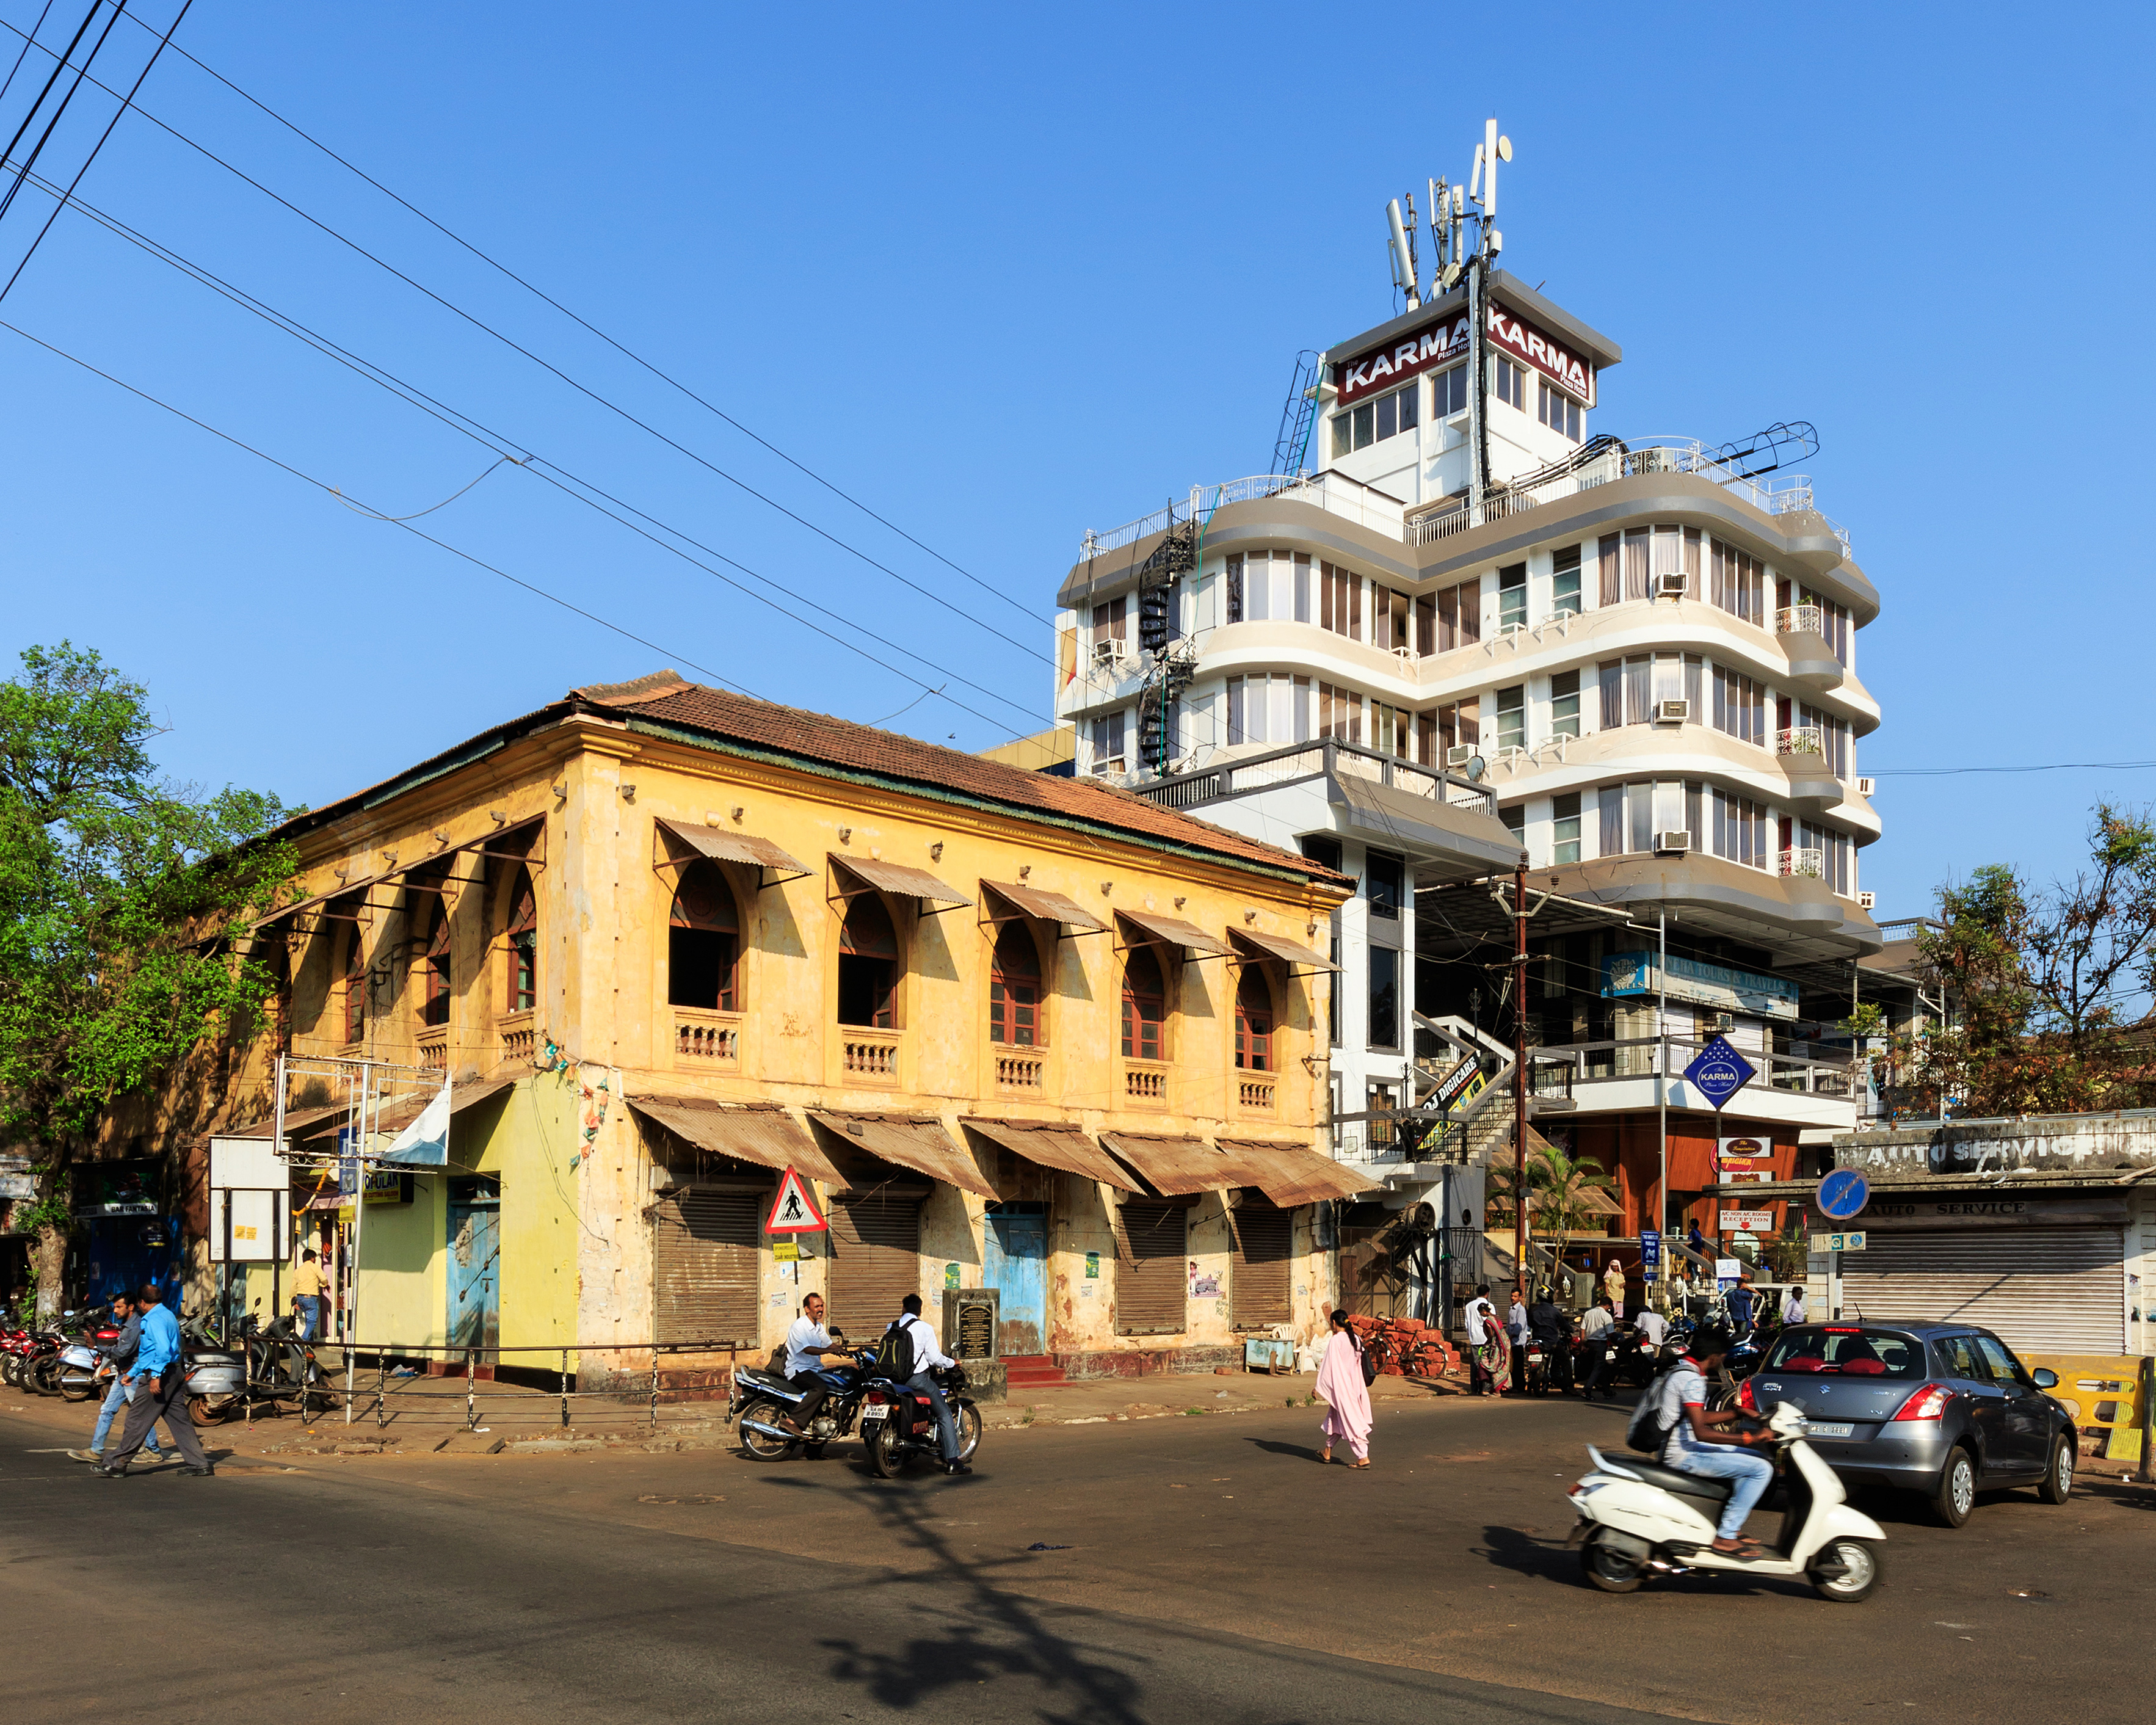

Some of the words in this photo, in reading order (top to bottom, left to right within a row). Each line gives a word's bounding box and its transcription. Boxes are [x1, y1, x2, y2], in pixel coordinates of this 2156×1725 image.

[1346, 317, 1470, 393] KARMA
[1438, 348, 1456, 360] Plaza
[1458, 343, 1470, 352] Hot
[1487, 305, 1586, 389] KARMA
[1347, 359, 1359, 368] The
[1560, 374, 1573, 388] Plaza
[1574, 383, 1586, 397] Hotel
[1666, 956, 1694, 975] NEHA
[1696, 964, 1730, 982] TOURS
[1733, 971, 1740, 984] &
[1744, 973, 1784, 990] TRAVELS
[1603, 981, 1644, 992] TRAVELS
[1438, 1056, 1477, 1102] DIGICARE
[1867, 1144, 1947, 1163] AUTO
[1953, 1134, 2104, 1161] SERVICE
[1868, 1205, 1915, 1216] AUTO
[1937, 1202, 2025, 1215] SERVICE
